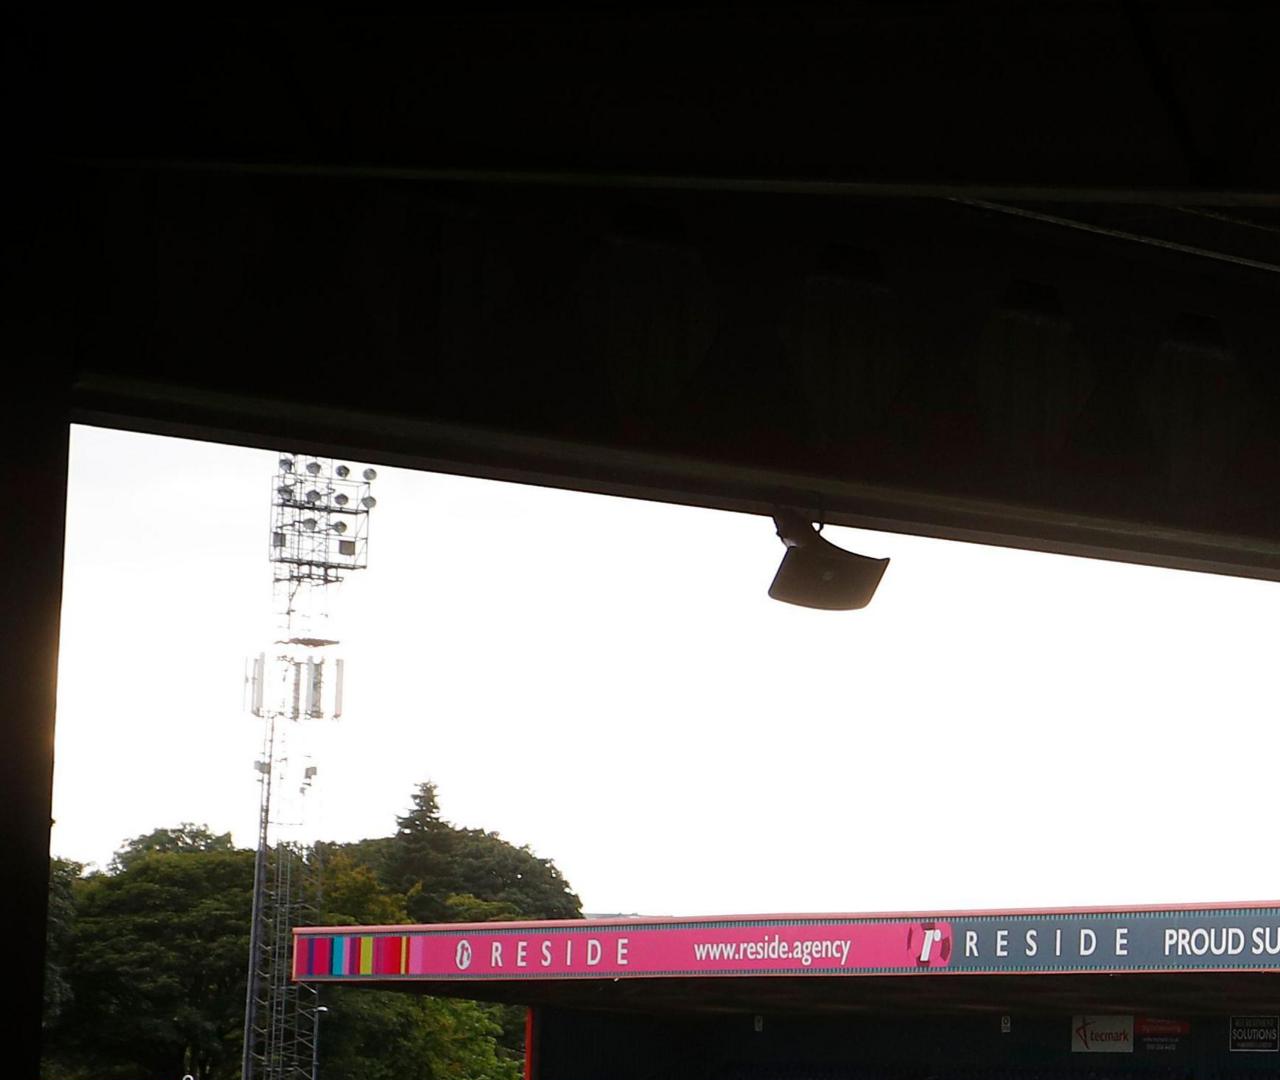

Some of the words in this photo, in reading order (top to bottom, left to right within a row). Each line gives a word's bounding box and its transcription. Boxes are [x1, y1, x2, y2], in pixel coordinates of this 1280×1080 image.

[491, 937, 629, 967] RESIDE
[694, 935, 852, 967] www.reside.agency
[965, 927, 1128, 957] RESIDE
[1164, 926, 1245, 956] PROUD
[1089, 1030, 1130, 1042] tecmark
[1232, 1028, 1278, 1041] SOLUTIONS
